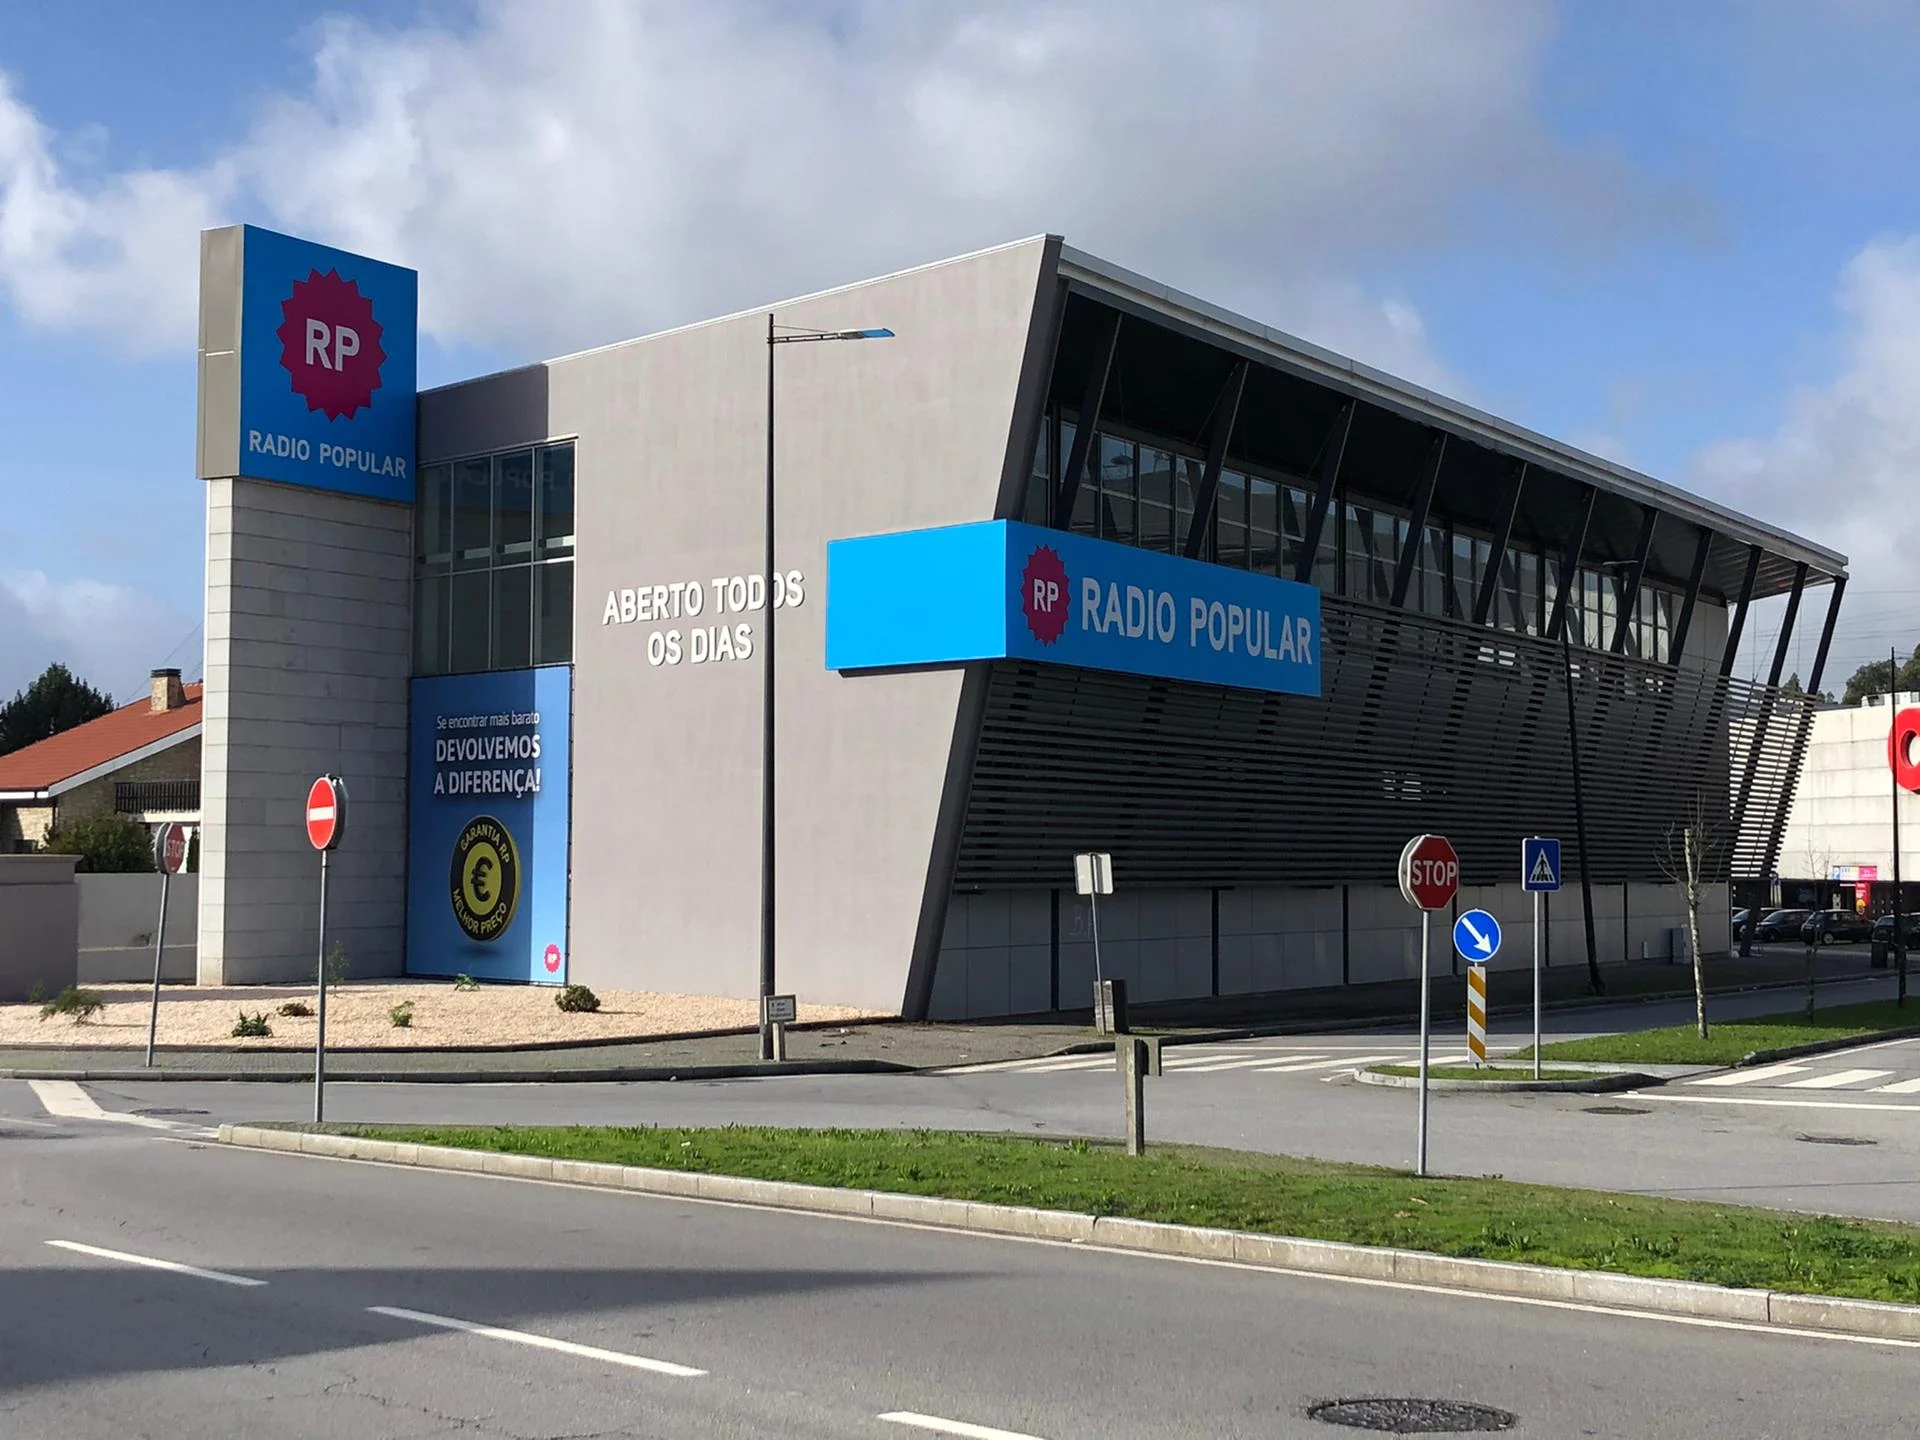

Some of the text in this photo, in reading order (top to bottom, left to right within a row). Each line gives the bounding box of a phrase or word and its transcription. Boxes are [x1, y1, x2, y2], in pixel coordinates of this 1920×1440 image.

[306, 318, 360, 372] RP
[249, 430, 407, 479] RADIO POPULAR
[602, 570, 804, 625] ABERTO TODOS
[1033, 577, 1312, 664] RP RADIO POPULAR
[647, 623, 753, 666] OS DIAS
[436, 710, 540, 729] Se encontrar mais barato
[436, 734, 541, 762] DEVOLVEMOS
[434, 768, 541, 799] A DIFERENÇA!
[167, 839, 185, 858] STOP
[460, 823, 511, 863] GARANTIA RP
[1411, 860, 1457, 887] STOP
[452, 888, 507, 934] MELHOR PREÇO
